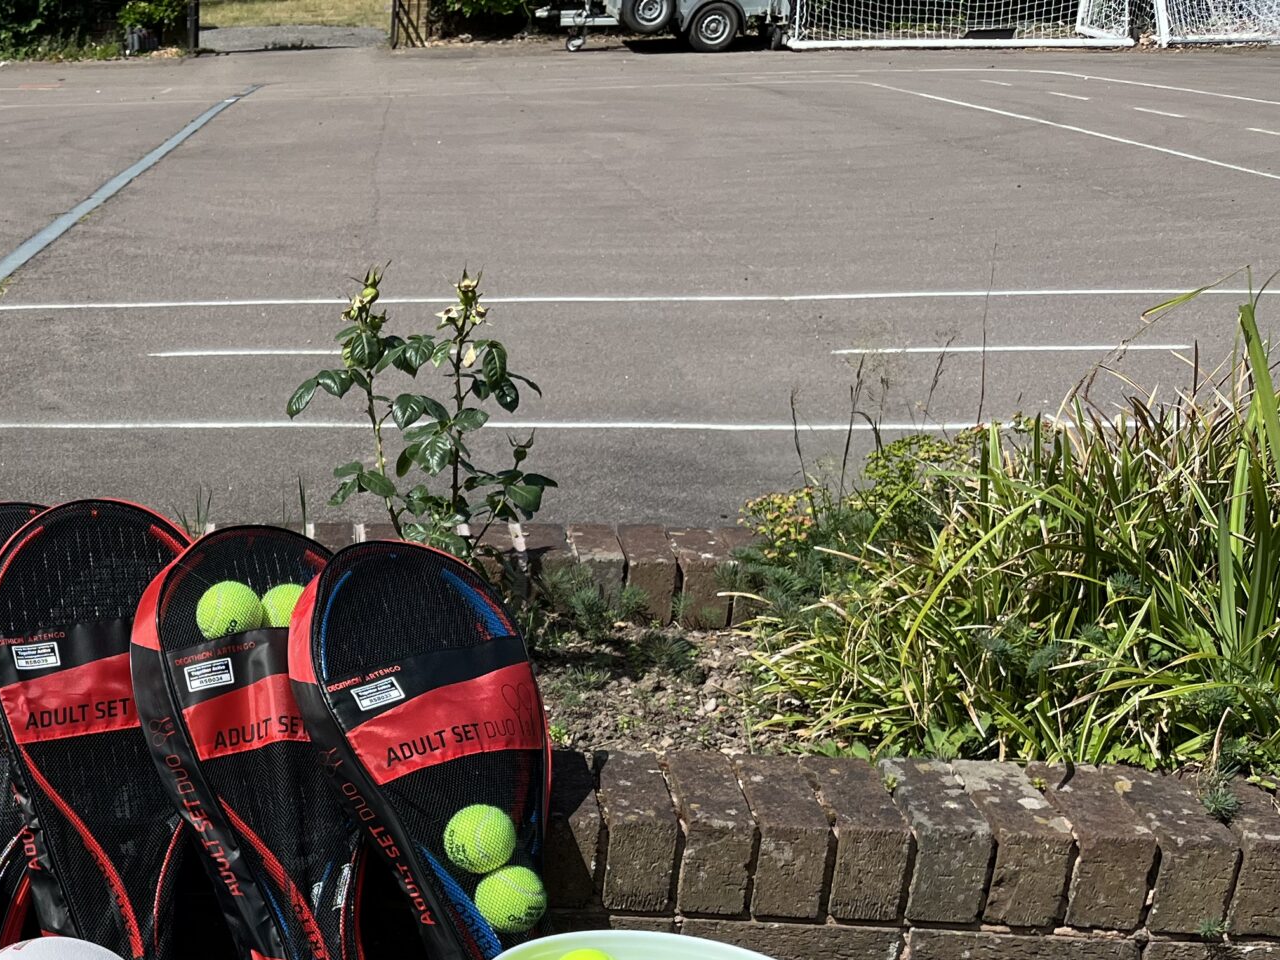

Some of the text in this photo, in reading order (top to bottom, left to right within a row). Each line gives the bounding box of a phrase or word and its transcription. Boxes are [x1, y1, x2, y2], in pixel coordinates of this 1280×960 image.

[28, 631, 66, 643] ARTENGO
[174, 650, 213, 666] DECATHLON
[216, 641, 256, 656] ARTENGO
[327, 665, 402, 693] DECATHLON ARTENGO
[25, 698, 131, 730] ADULT SET
[213, 717, 272, 751] ADULT
[385, 717, 516, 767] ADULT SET DUO
[165, 754, 245, 897] ADULT SET DUO
[22, 831, 43, 871] ADU
[341, 782, 437, 926] ADULT SET DUO
